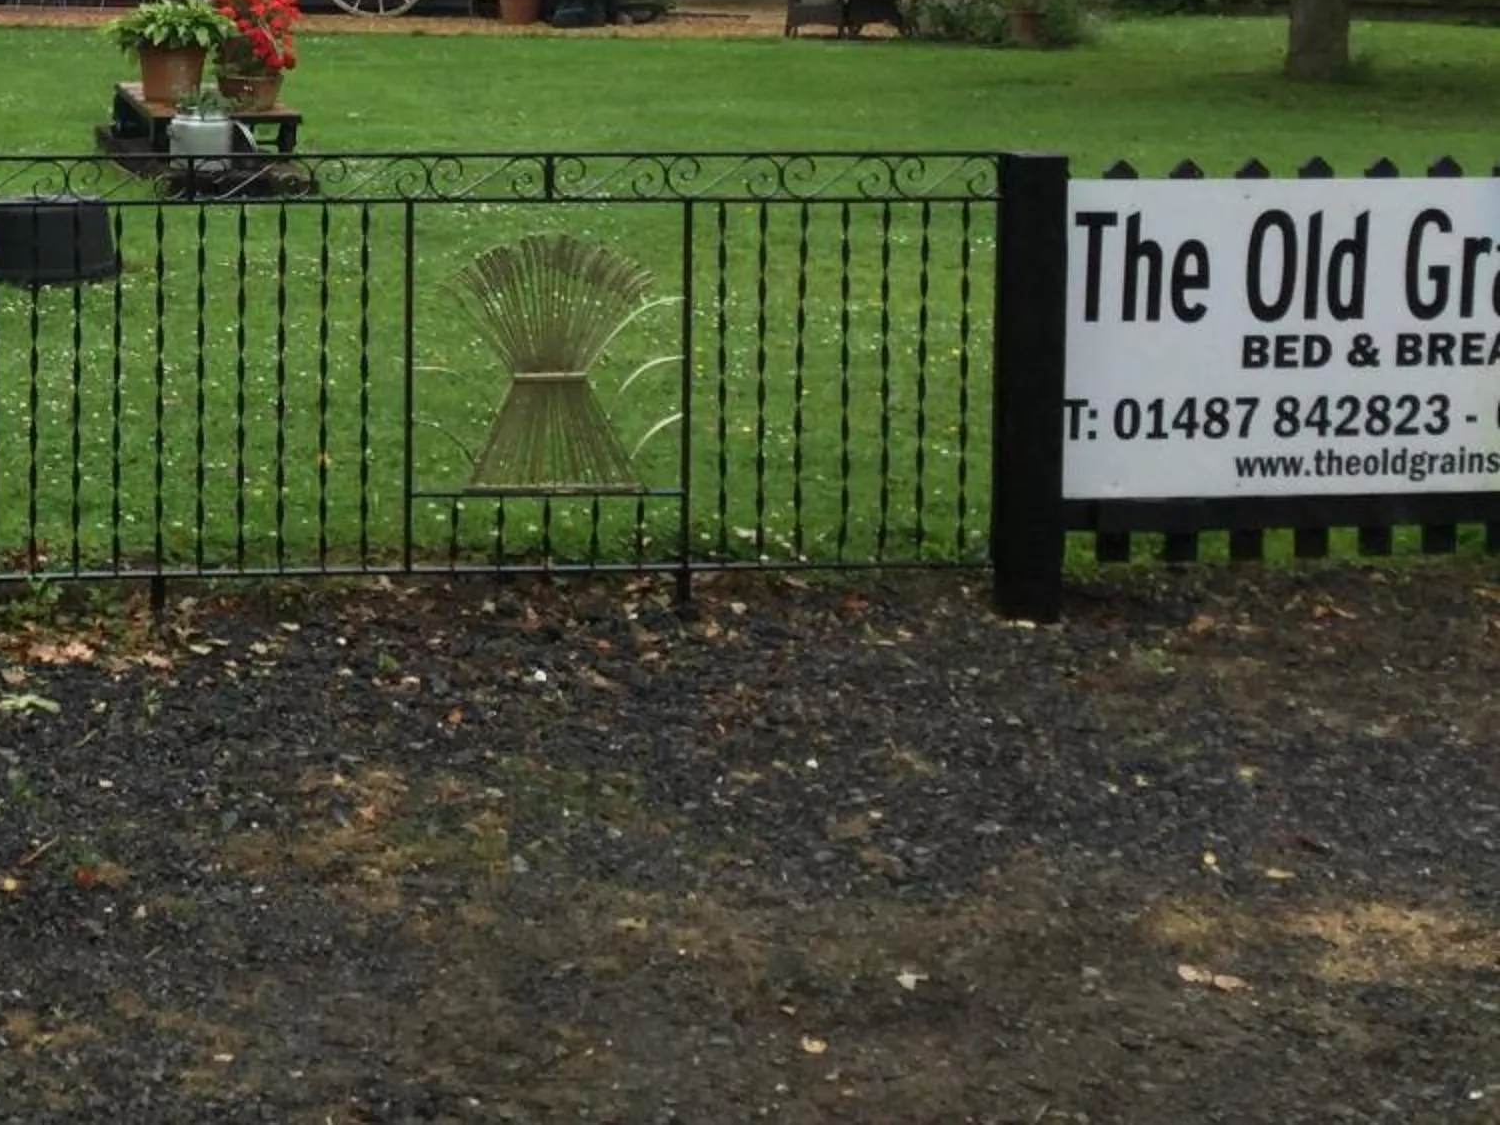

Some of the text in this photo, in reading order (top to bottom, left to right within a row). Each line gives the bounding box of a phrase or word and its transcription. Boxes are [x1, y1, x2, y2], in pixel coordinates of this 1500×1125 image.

[1075, 208, 1500, 323] The Old Gr
[1242, 336, 1332, 369] BED
[1347, 333, 1380, 367] &
[1064, 399, 1098, 441] T:
[1113, 396, 1259, 441] 01487
[1273, 394, 1451, 438] 842823
[1235, 446, 1500, 482] www.theoldgrains
